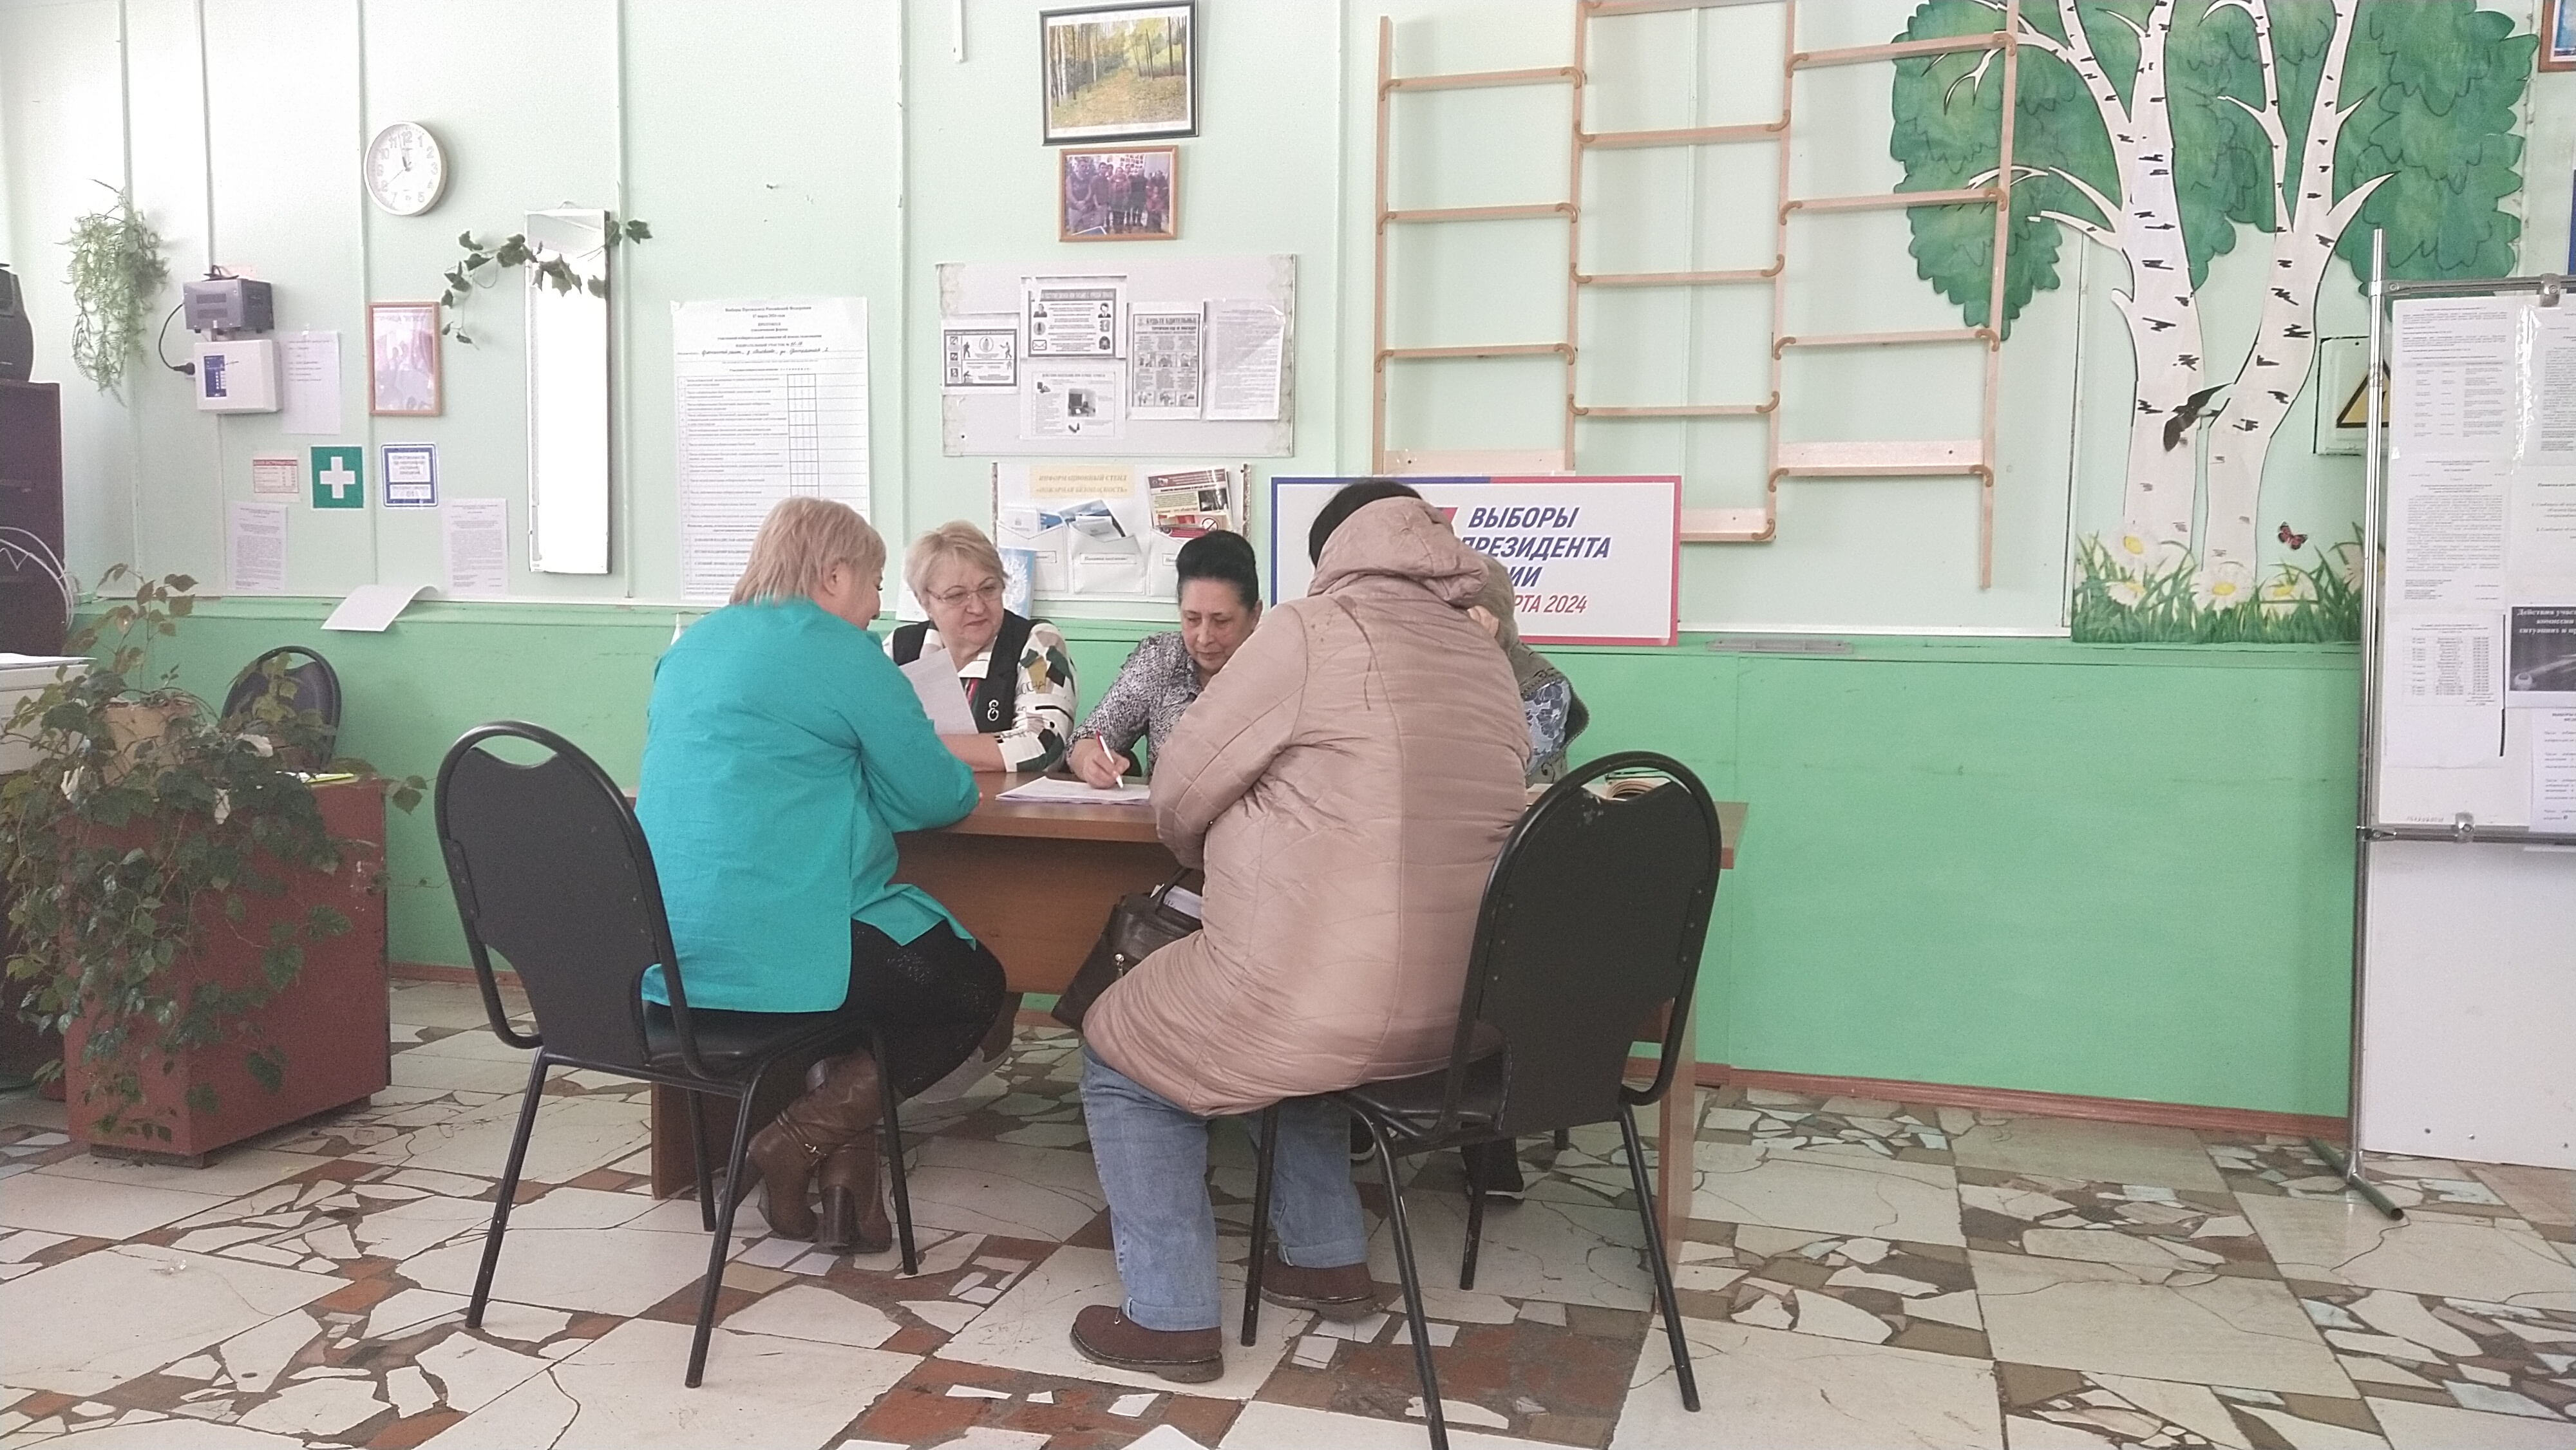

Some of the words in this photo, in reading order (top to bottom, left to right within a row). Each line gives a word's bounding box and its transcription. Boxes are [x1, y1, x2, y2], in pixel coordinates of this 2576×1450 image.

[426, 146, 435, 159] 2
[417, 192, 425, 203] 5
[1468, 507, 1580, 528] ВЫБОРЫ
[1462, 537, 1611, 561] ПРЕЗИДЕНТА
[1515, 595, 1542, 612] РТА
[1544, 595, 1587, 613] 2024
